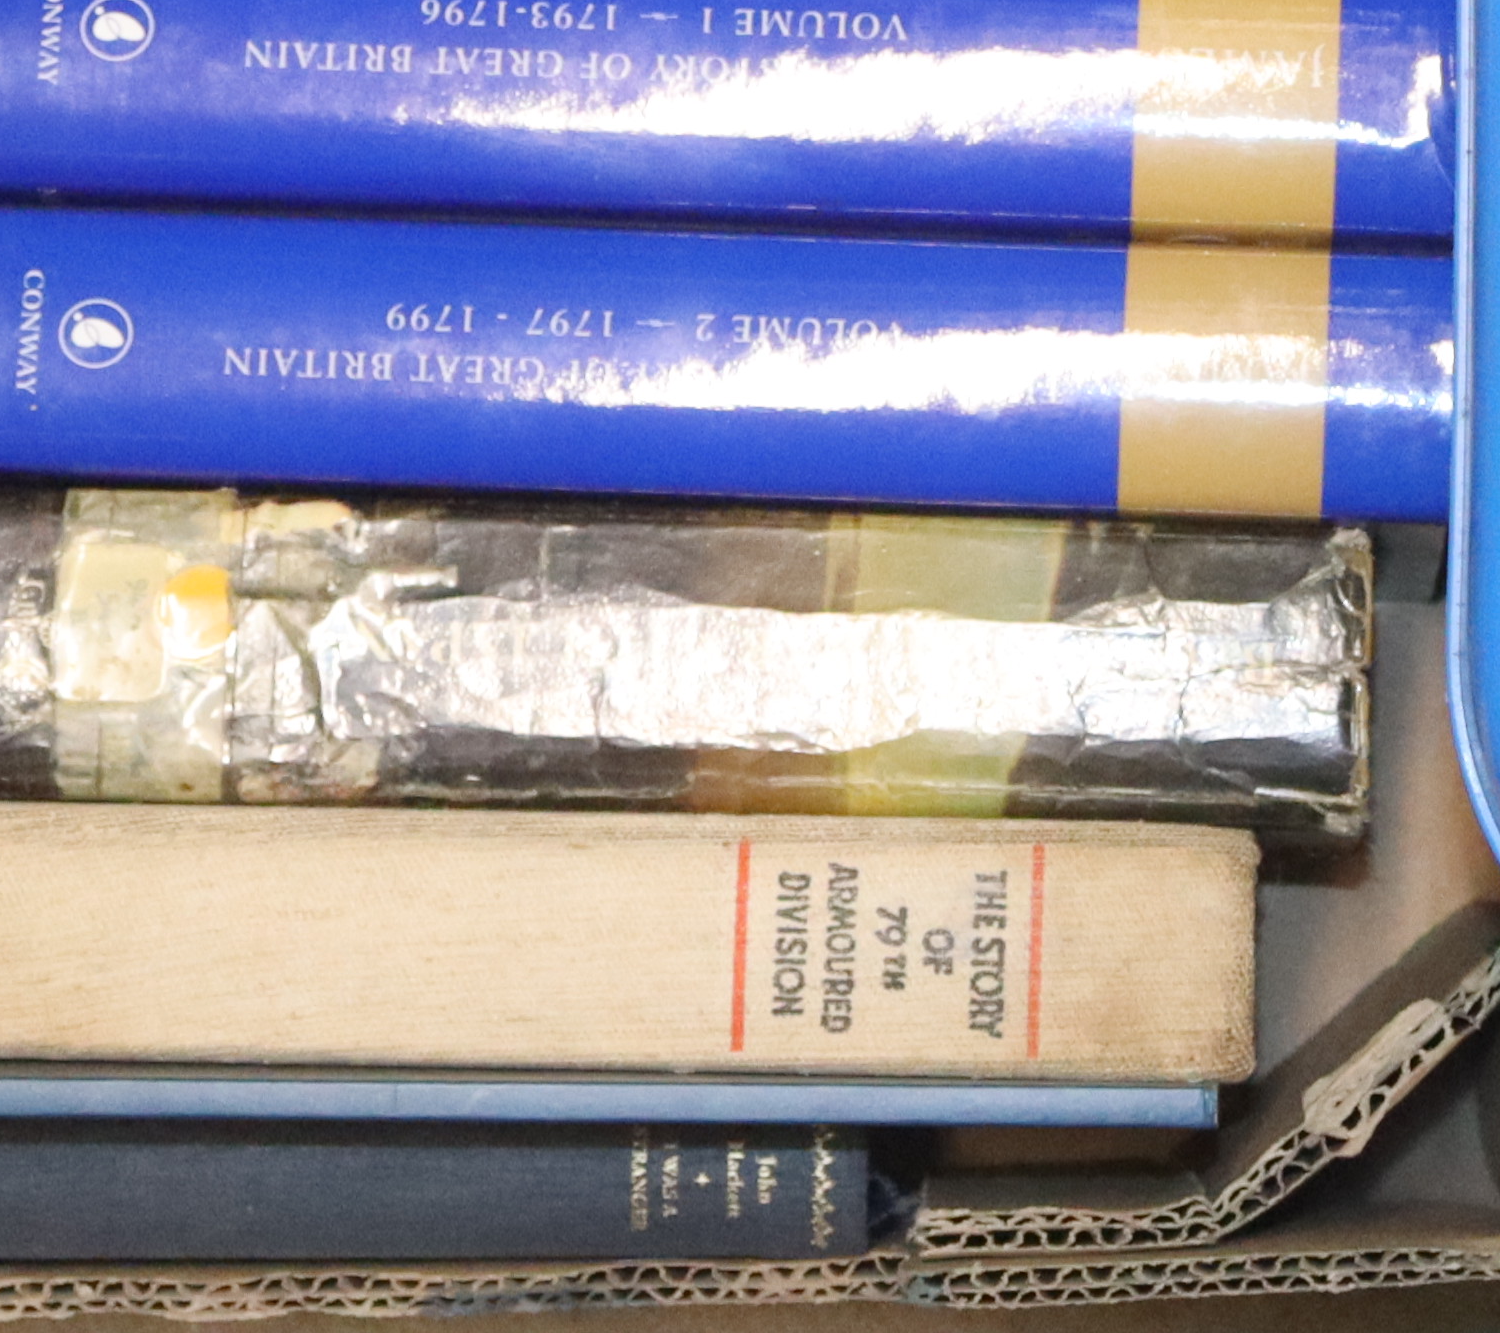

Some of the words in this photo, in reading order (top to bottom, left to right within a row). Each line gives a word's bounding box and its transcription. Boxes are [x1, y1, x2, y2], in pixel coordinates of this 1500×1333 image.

[421, 0, 616, 30] 1793-1796
[15, 271, 43, 393] CONWAY
[772, 872, 810, 1016] DIVISION
[821, 863, 858, 1033] ARMOURED
[973, 871, 1007, 929] THE
[923, 929, 954, 975] OF
[970, 939, 1005, 1038] STORY
